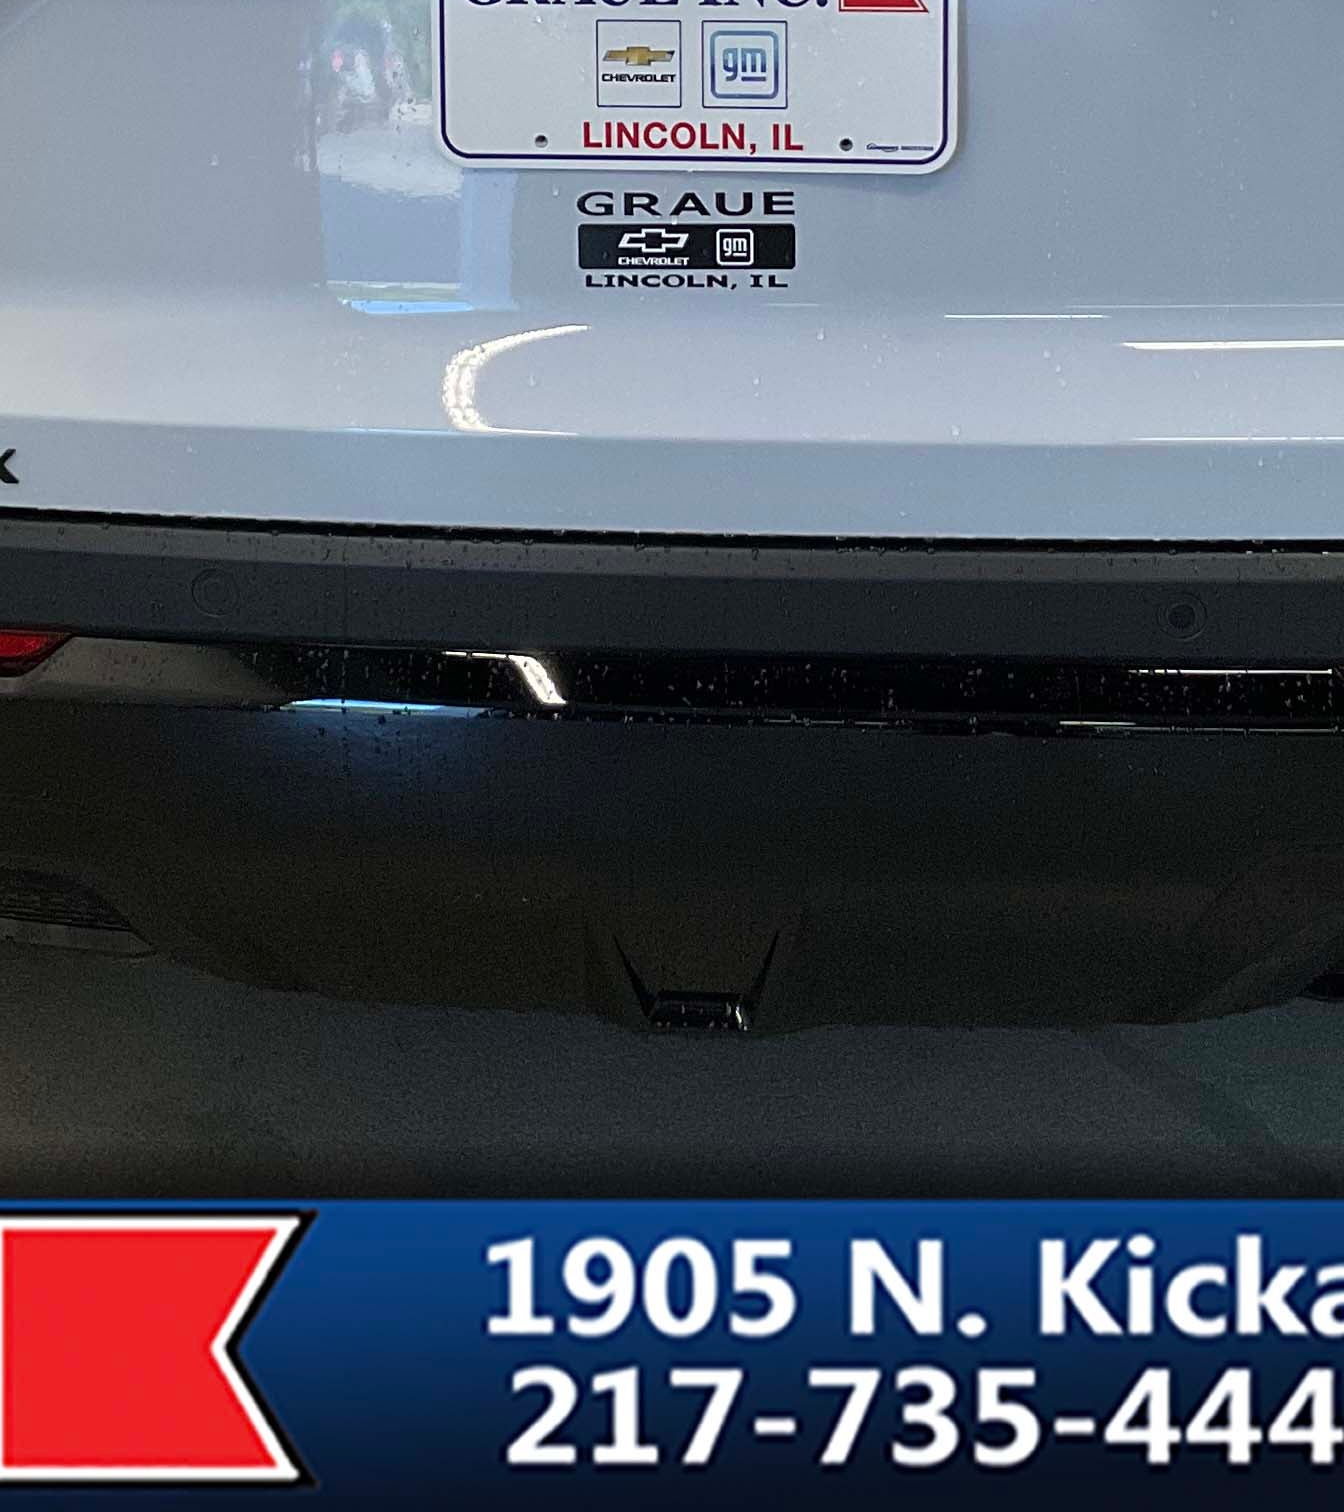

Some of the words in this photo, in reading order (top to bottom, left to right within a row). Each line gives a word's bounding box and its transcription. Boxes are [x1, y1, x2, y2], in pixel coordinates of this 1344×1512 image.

[721, 46, 768, 83] gm
[601, 73, 677, 84] CHEVROLET
[582, 121, 757, 155] LINCOLN,
[772, 124, 804, 151] IL
[576, 190, 796, 217] GRAUE
[722, 236, 748, 258] gm
[617, 256, 690, 267] CHEVROLET
[584, 273, 737, 290] LINCOLN,
[750, 273, 789, 289] IL
